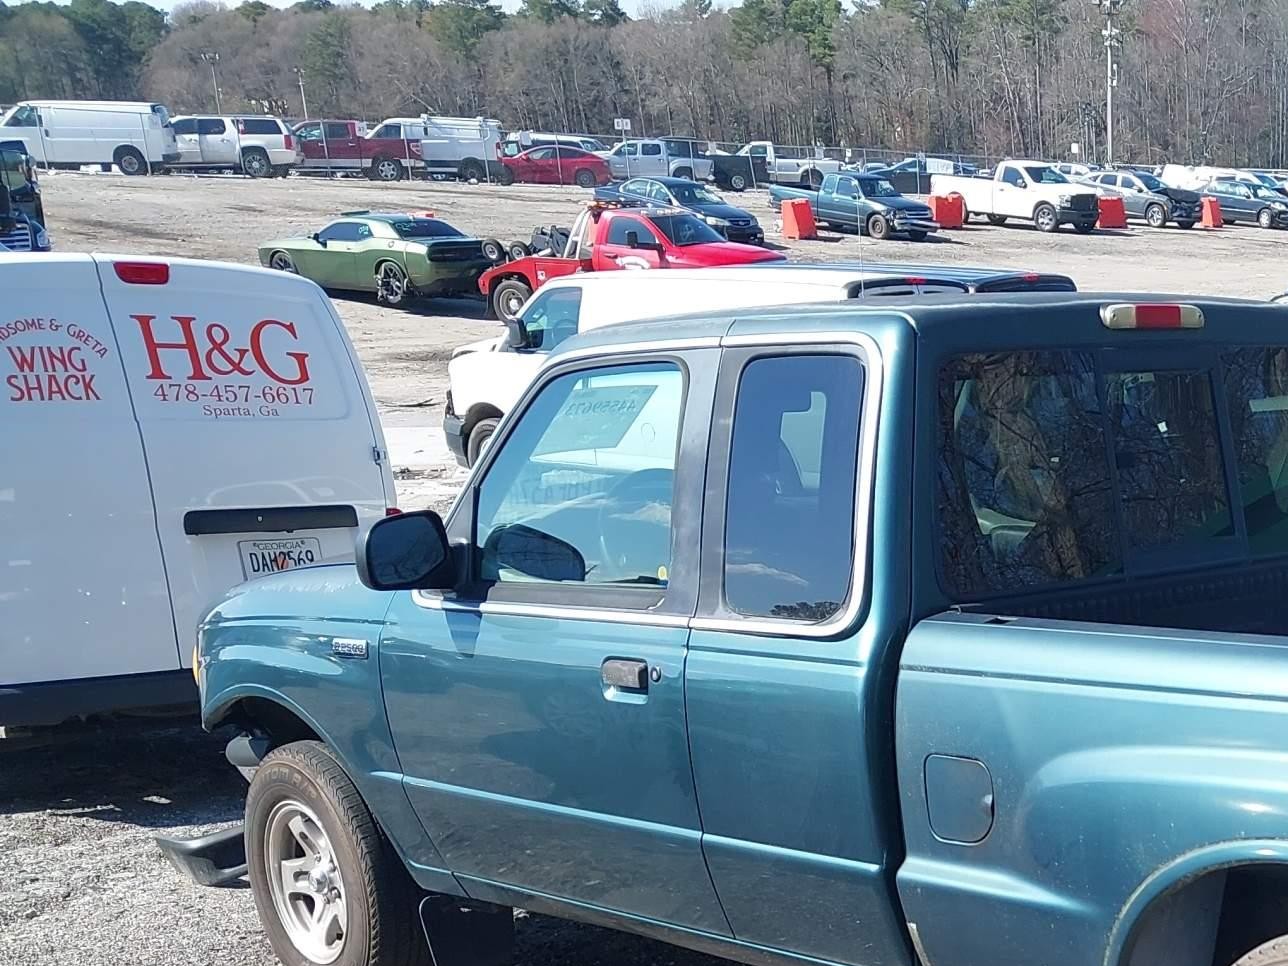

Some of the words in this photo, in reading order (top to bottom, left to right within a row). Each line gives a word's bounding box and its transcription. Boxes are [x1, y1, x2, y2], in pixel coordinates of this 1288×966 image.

[49, 318, 63, 331] &
[66, 323, 109, 359] GRETA
[129, 314, 311, 386] H&G
[7, 346, 88, 373] WING
[6, 374, 102, 401] SHACK
[153, 383, 315, 405] 478-457-6617
[202, 405, 256, 418] Sparta,
[258, 406, 280, 417] Ga
[258, 541, 302, 551] GEORGIA
